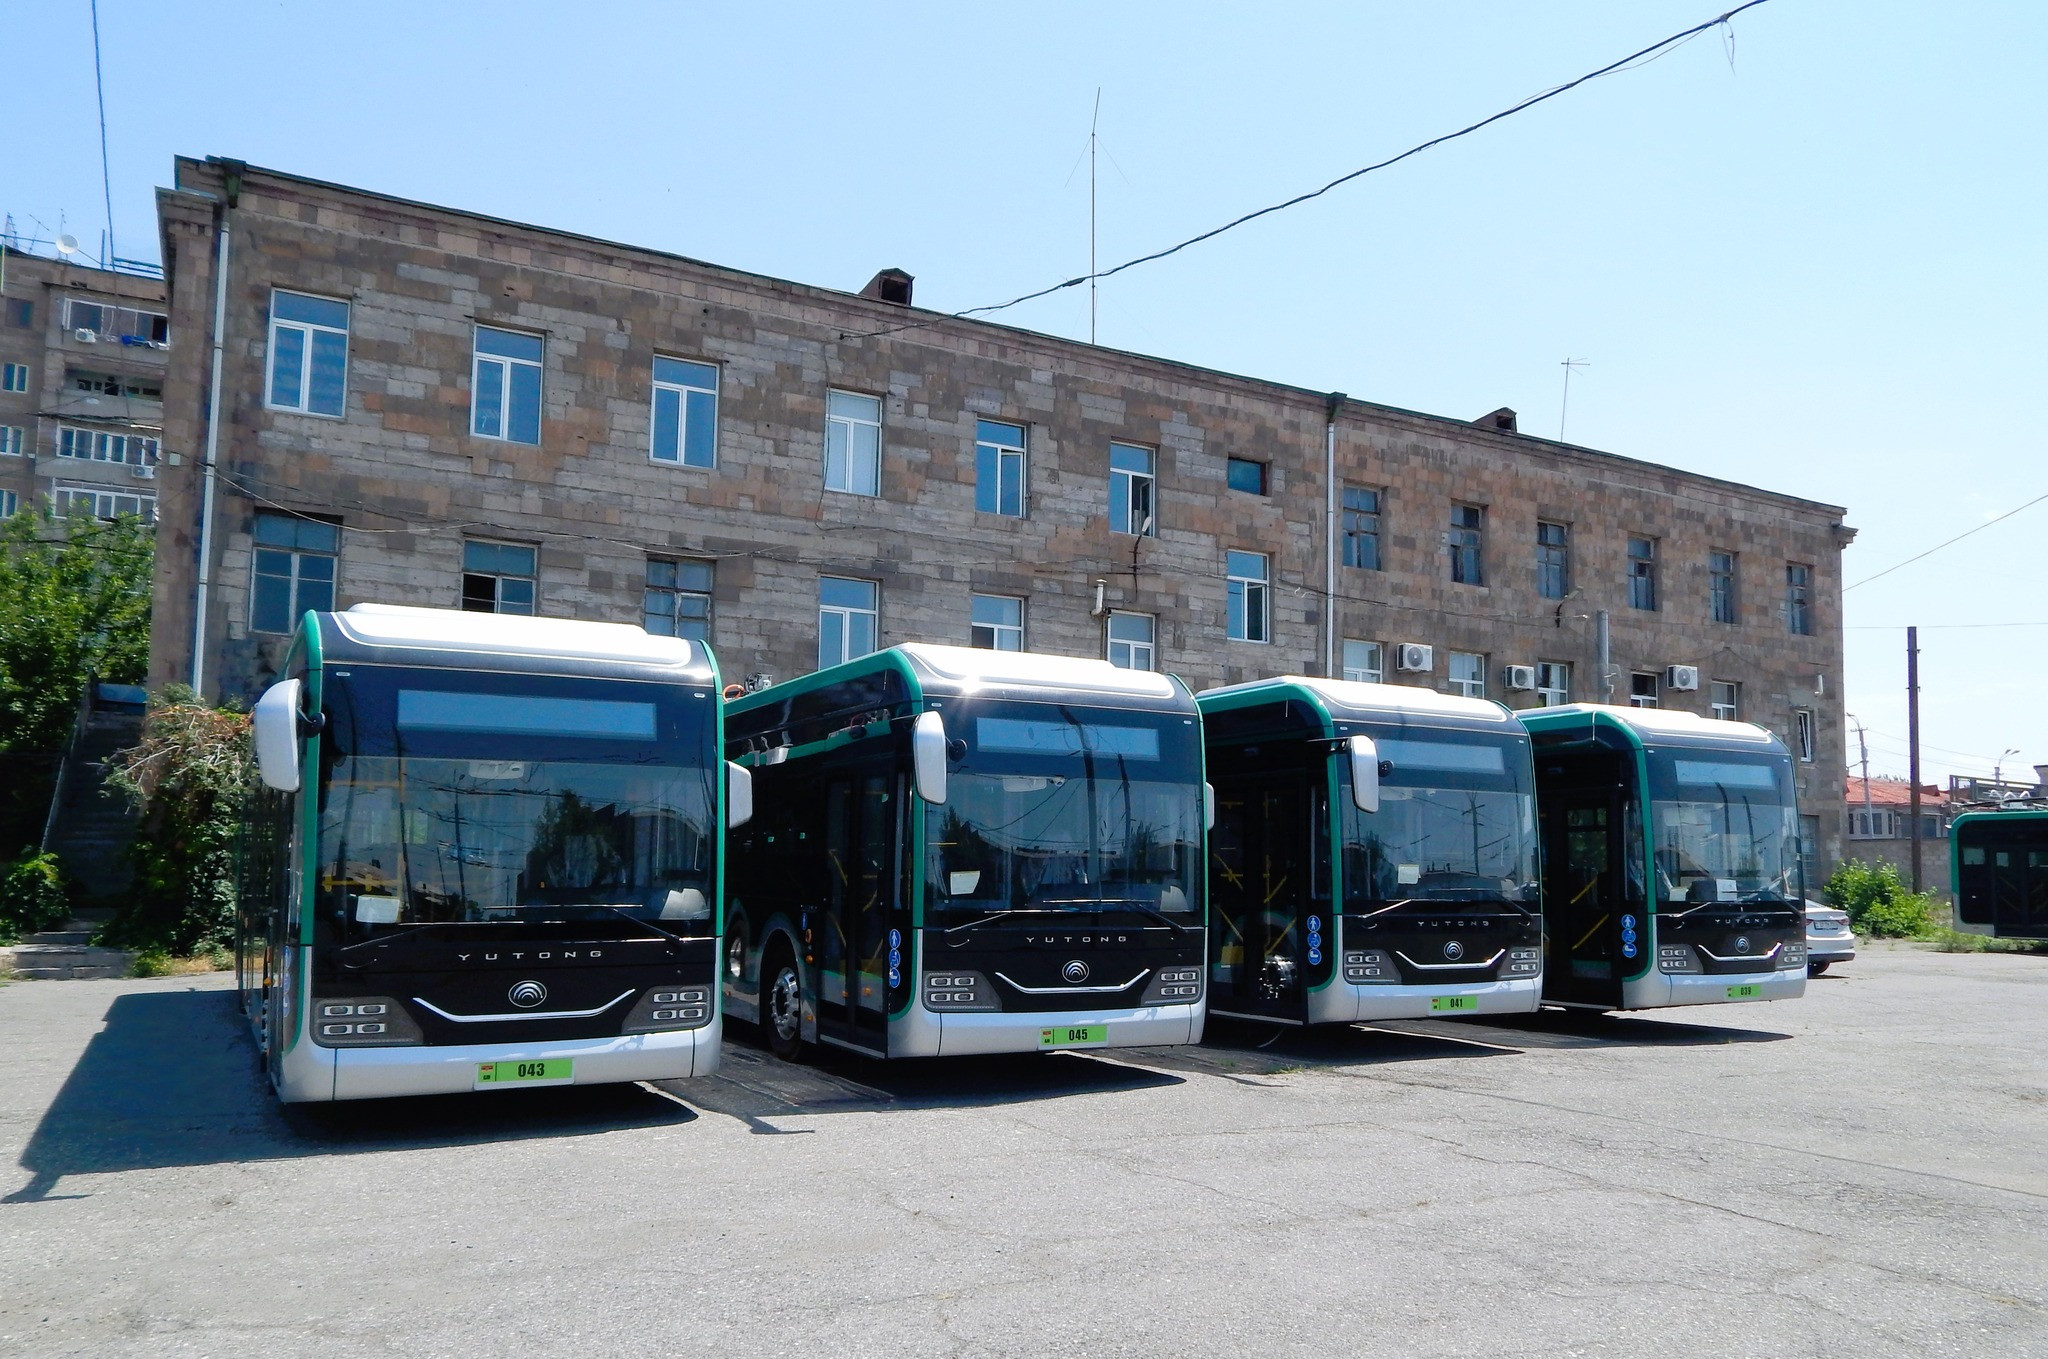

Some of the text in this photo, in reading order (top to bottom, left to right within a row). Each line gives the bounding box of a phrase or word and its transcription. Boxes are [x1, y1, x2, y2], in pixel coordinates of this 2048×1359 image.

[458, 950, 602, 961] YUTONG
[1450, 998, 1463, 1008] 041
[1068, 1029, 1088, 1041] 045
[518, 1063, 545, 1077] 043
